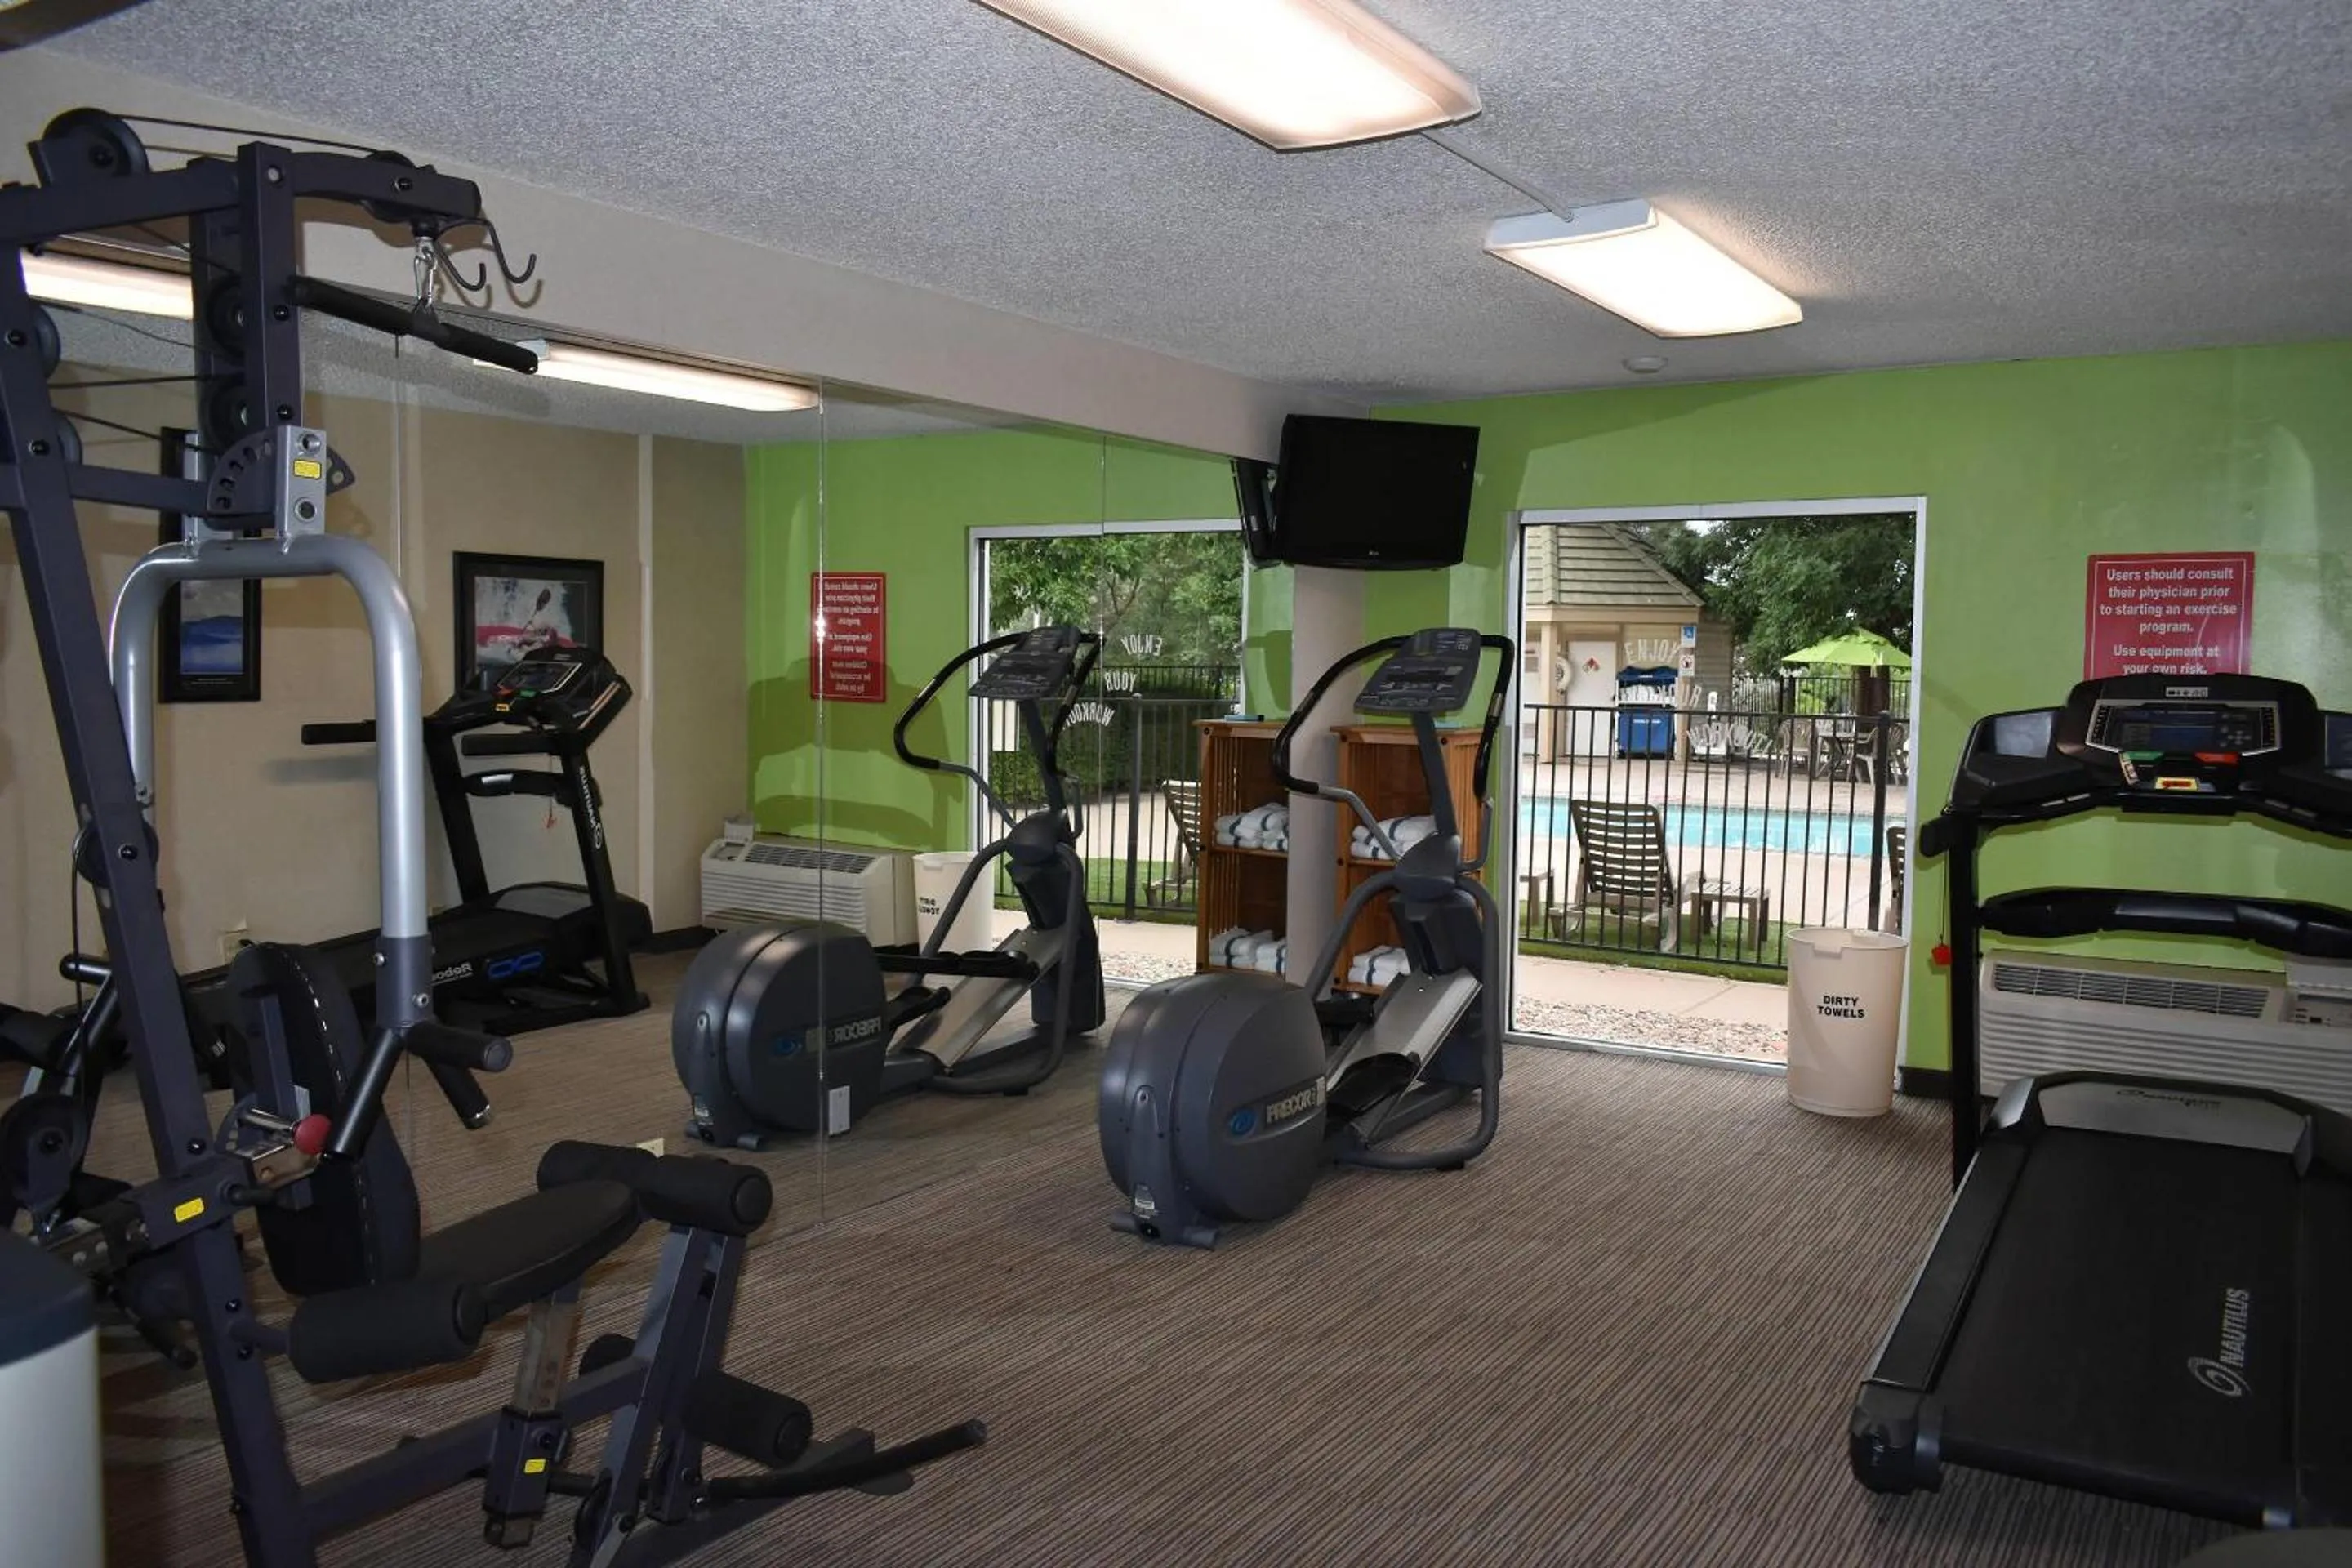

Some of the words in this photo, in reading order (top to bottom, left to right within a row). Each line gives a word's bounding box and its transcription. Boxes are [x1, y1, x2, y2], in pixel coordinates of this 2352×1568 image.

[2107, 568, 2141, 581] Users
[2144, 568, 2185, 580] should
[2188, 567, 2234, 579] consult
[2108, 587, 2136, 598] their
[2140, 586, 2198, 599] physician
[2200, 586, 2231, 599] prior
[2100, 604, 2112, 615] to
[2115, 604, 2163, 617] starting
[2165, 605, 2181, 615] an
[2184, 603, 2238, 614] exercise
[2140, 623, 2194, 635] program.
[1624, 639, 1682, 664] ENJOY
[2114, 644, 2136, 657] Use
[2140, 645, 2203, 660] equipment
[2206, 645, 2220, 657] at
[2123, 664, 2149, 676] your
[2152, 665, 2178, 674] own
[2180, 662, 2207, 675] risk.
[1823, 995, 1860, 1007] DIRTY
[1817, 1004, 1865, 1018] TOWELS
[1267, 1088, 1312, 1124] PRECOR
[2219, 1287, 2251, 1368] NAUTILUS
